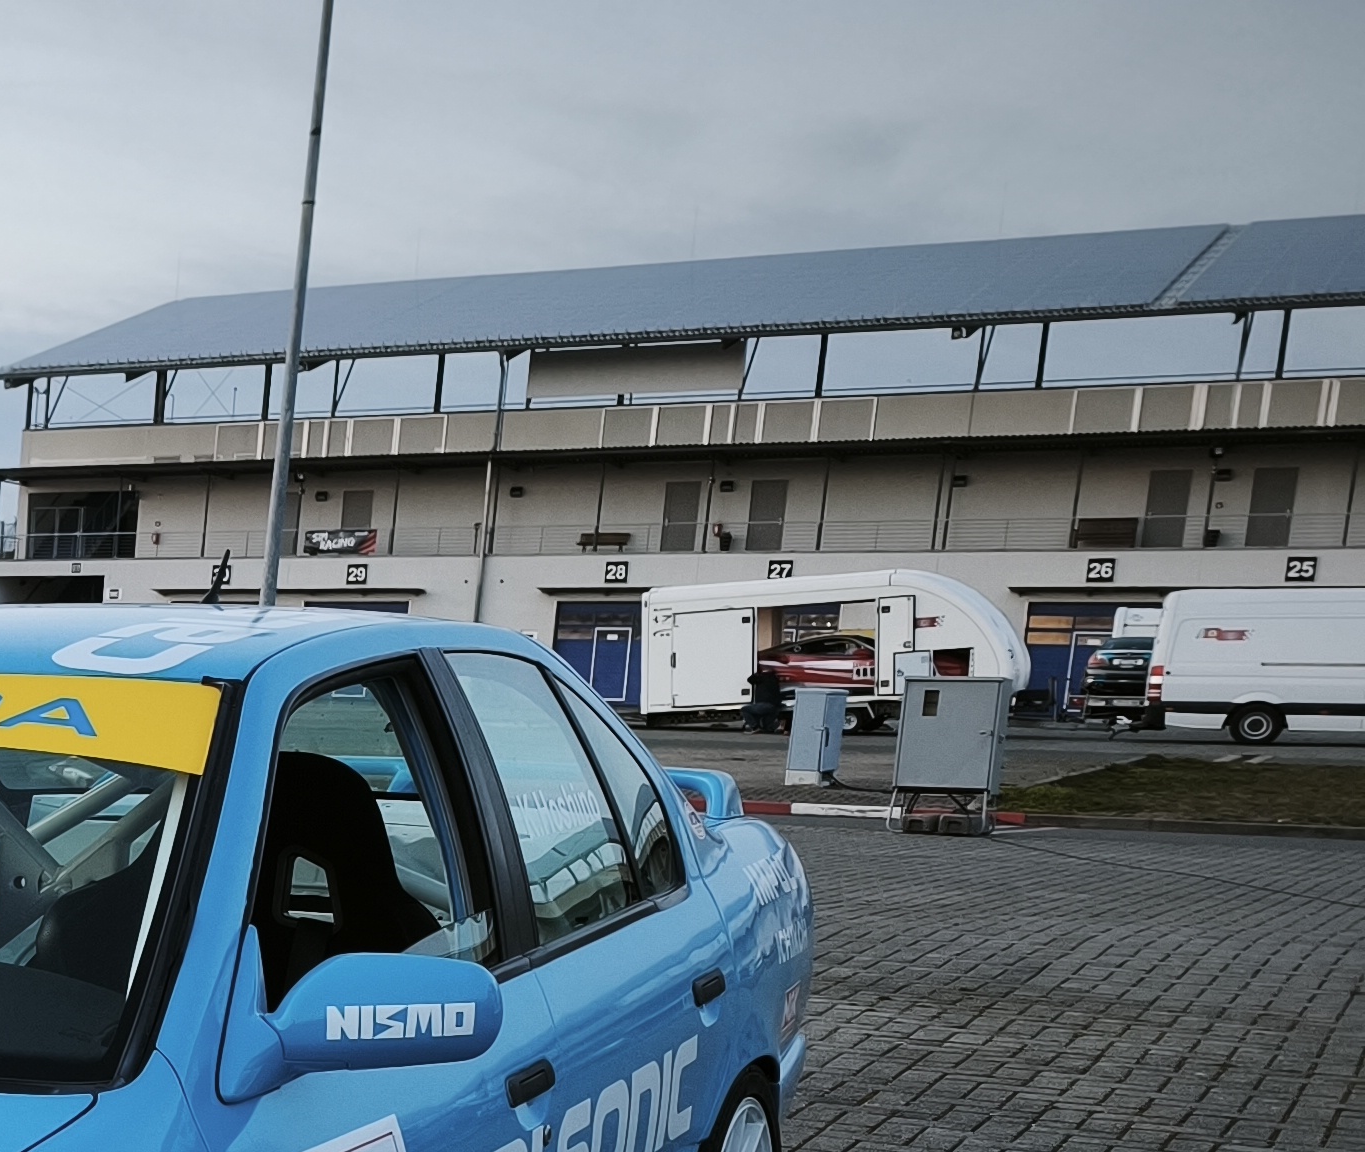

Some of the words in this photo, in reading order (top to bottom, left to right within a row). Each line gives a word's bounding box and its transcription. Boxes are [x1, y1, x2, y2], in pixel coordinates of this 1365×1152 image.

[348, 566, 366, 582] 29
[607, 565, 626, 580] 28
[771, 564, 791, 578] 27
[1089, 563, 1114, 580] 26
[1288, 562, 1315, 579] 25
[326, 1002, 476, 1041] NISMO
